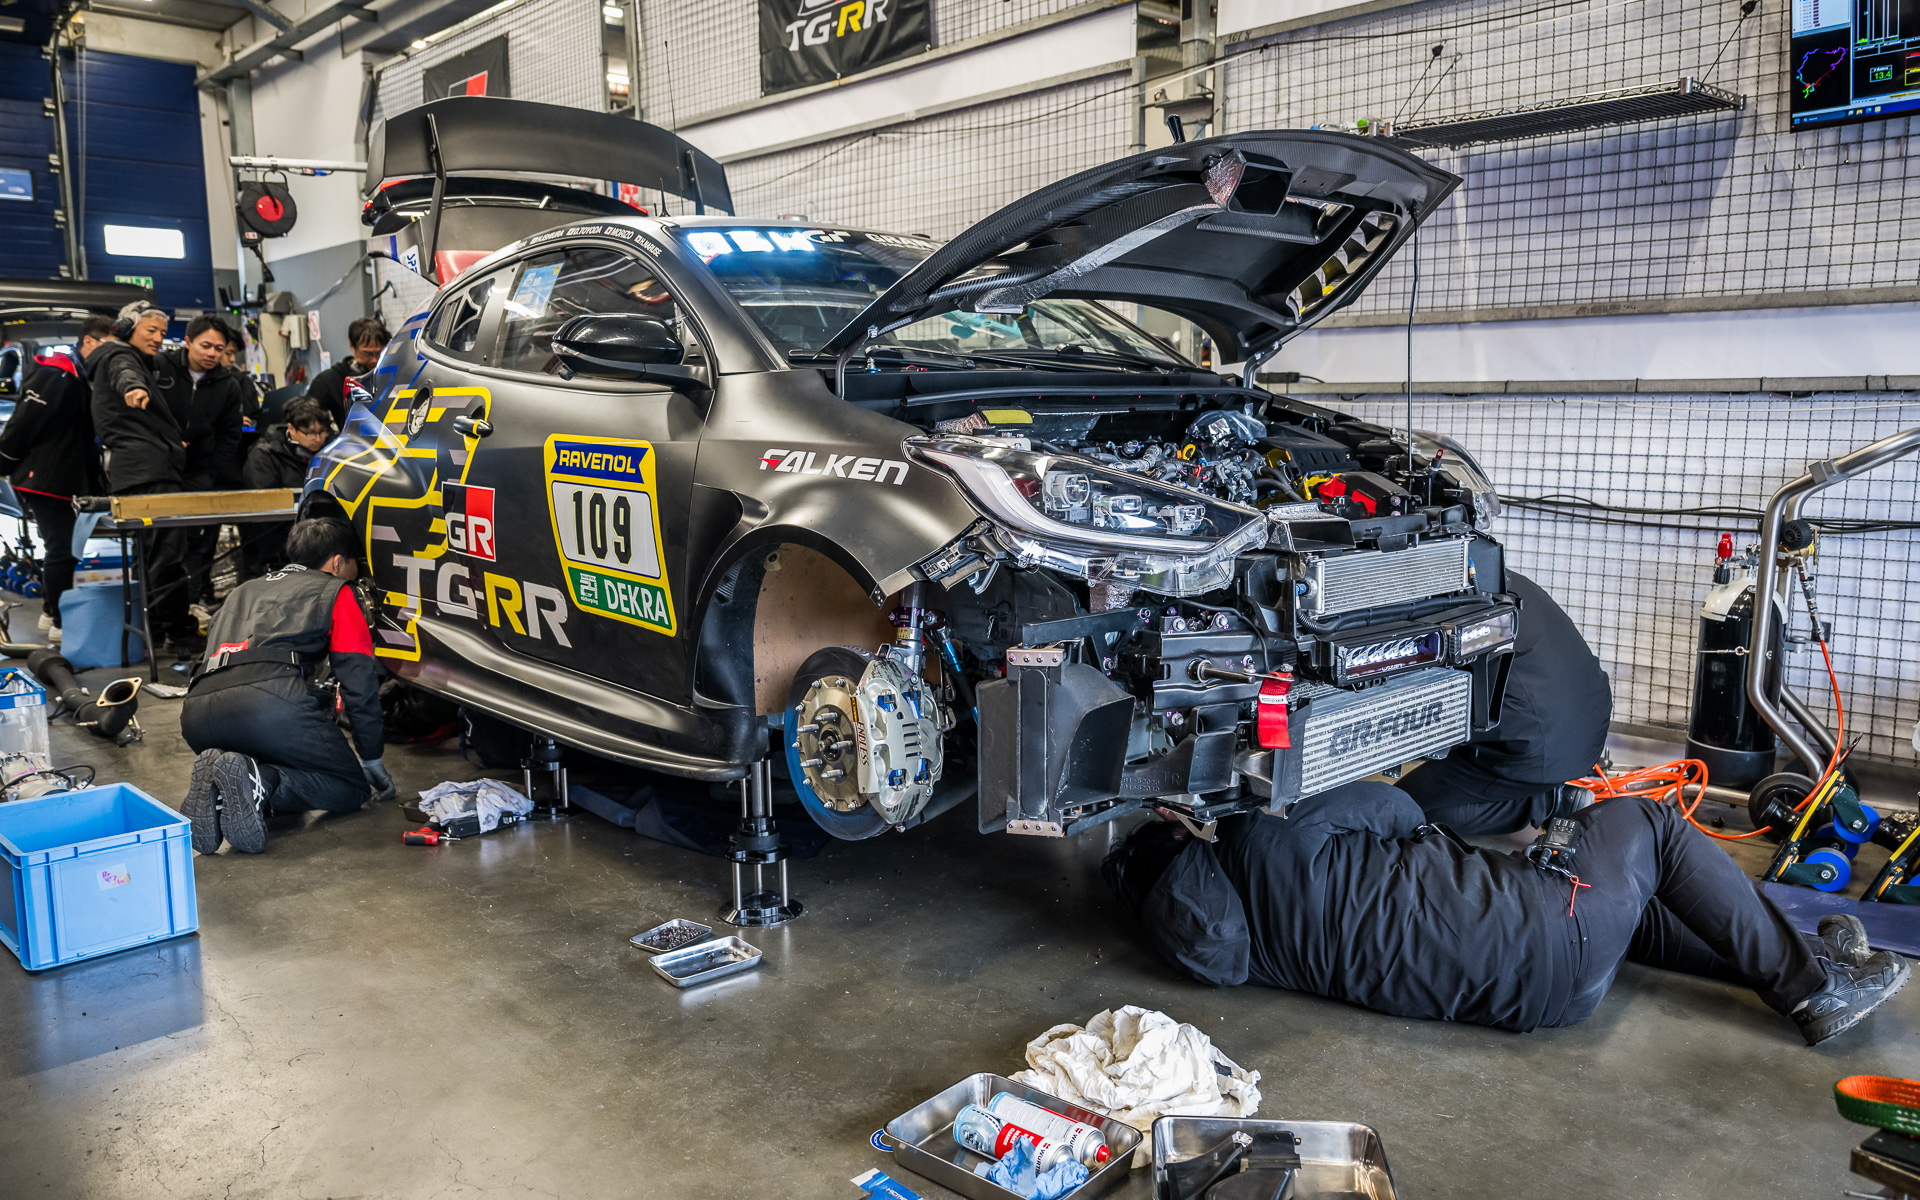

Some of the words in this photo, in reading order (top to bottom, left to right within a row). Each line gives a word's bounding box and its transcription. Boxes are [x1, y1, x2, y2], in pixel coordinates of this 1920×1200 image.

[785, 0, 889, 51] TG-RR
[610, 227, 635, 239] MORIZO
[559, 449, 636, 474] RAVENOL
[758, 448, 910, 486] FALKEN
[445, 512, 494, 557] GR
[571, 487, 633, 567] 109
[393, 553, 573, 649] TG-RR
[603, 579, 669, 625] DEKRA
[856, 720, 869, 766] ENDLESS
